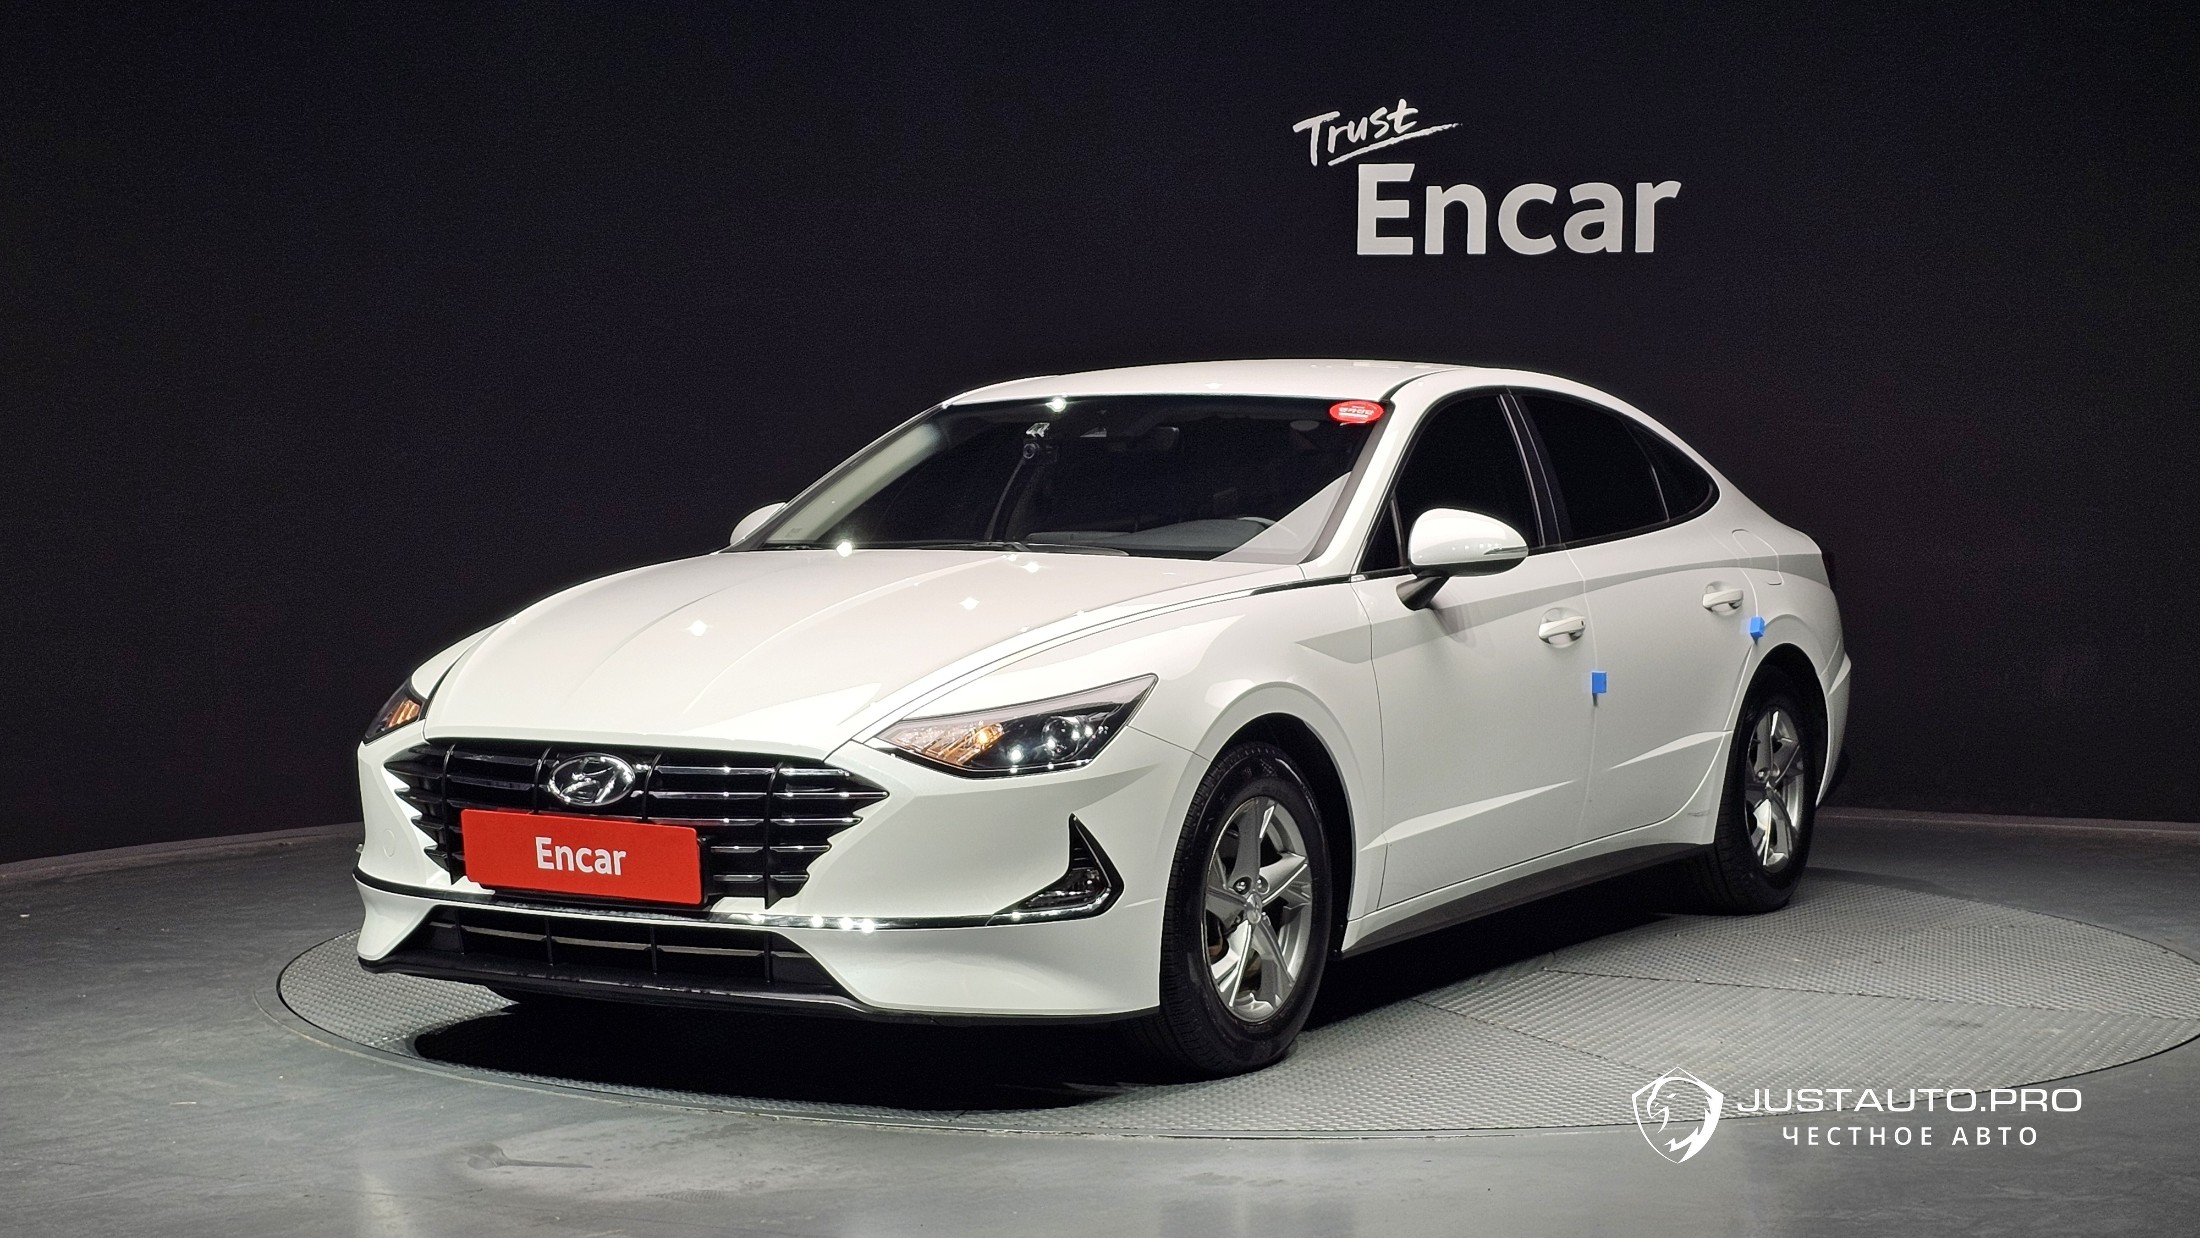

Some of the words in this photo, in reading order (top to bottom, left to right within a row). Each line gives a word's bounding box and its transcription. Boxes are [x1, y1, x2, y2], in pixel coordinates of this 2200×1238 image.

[1293, 98, 1419, 166] Trust
[1357, 163, 1682, 255] Encar
[535, 836, 627, 876] Encar
